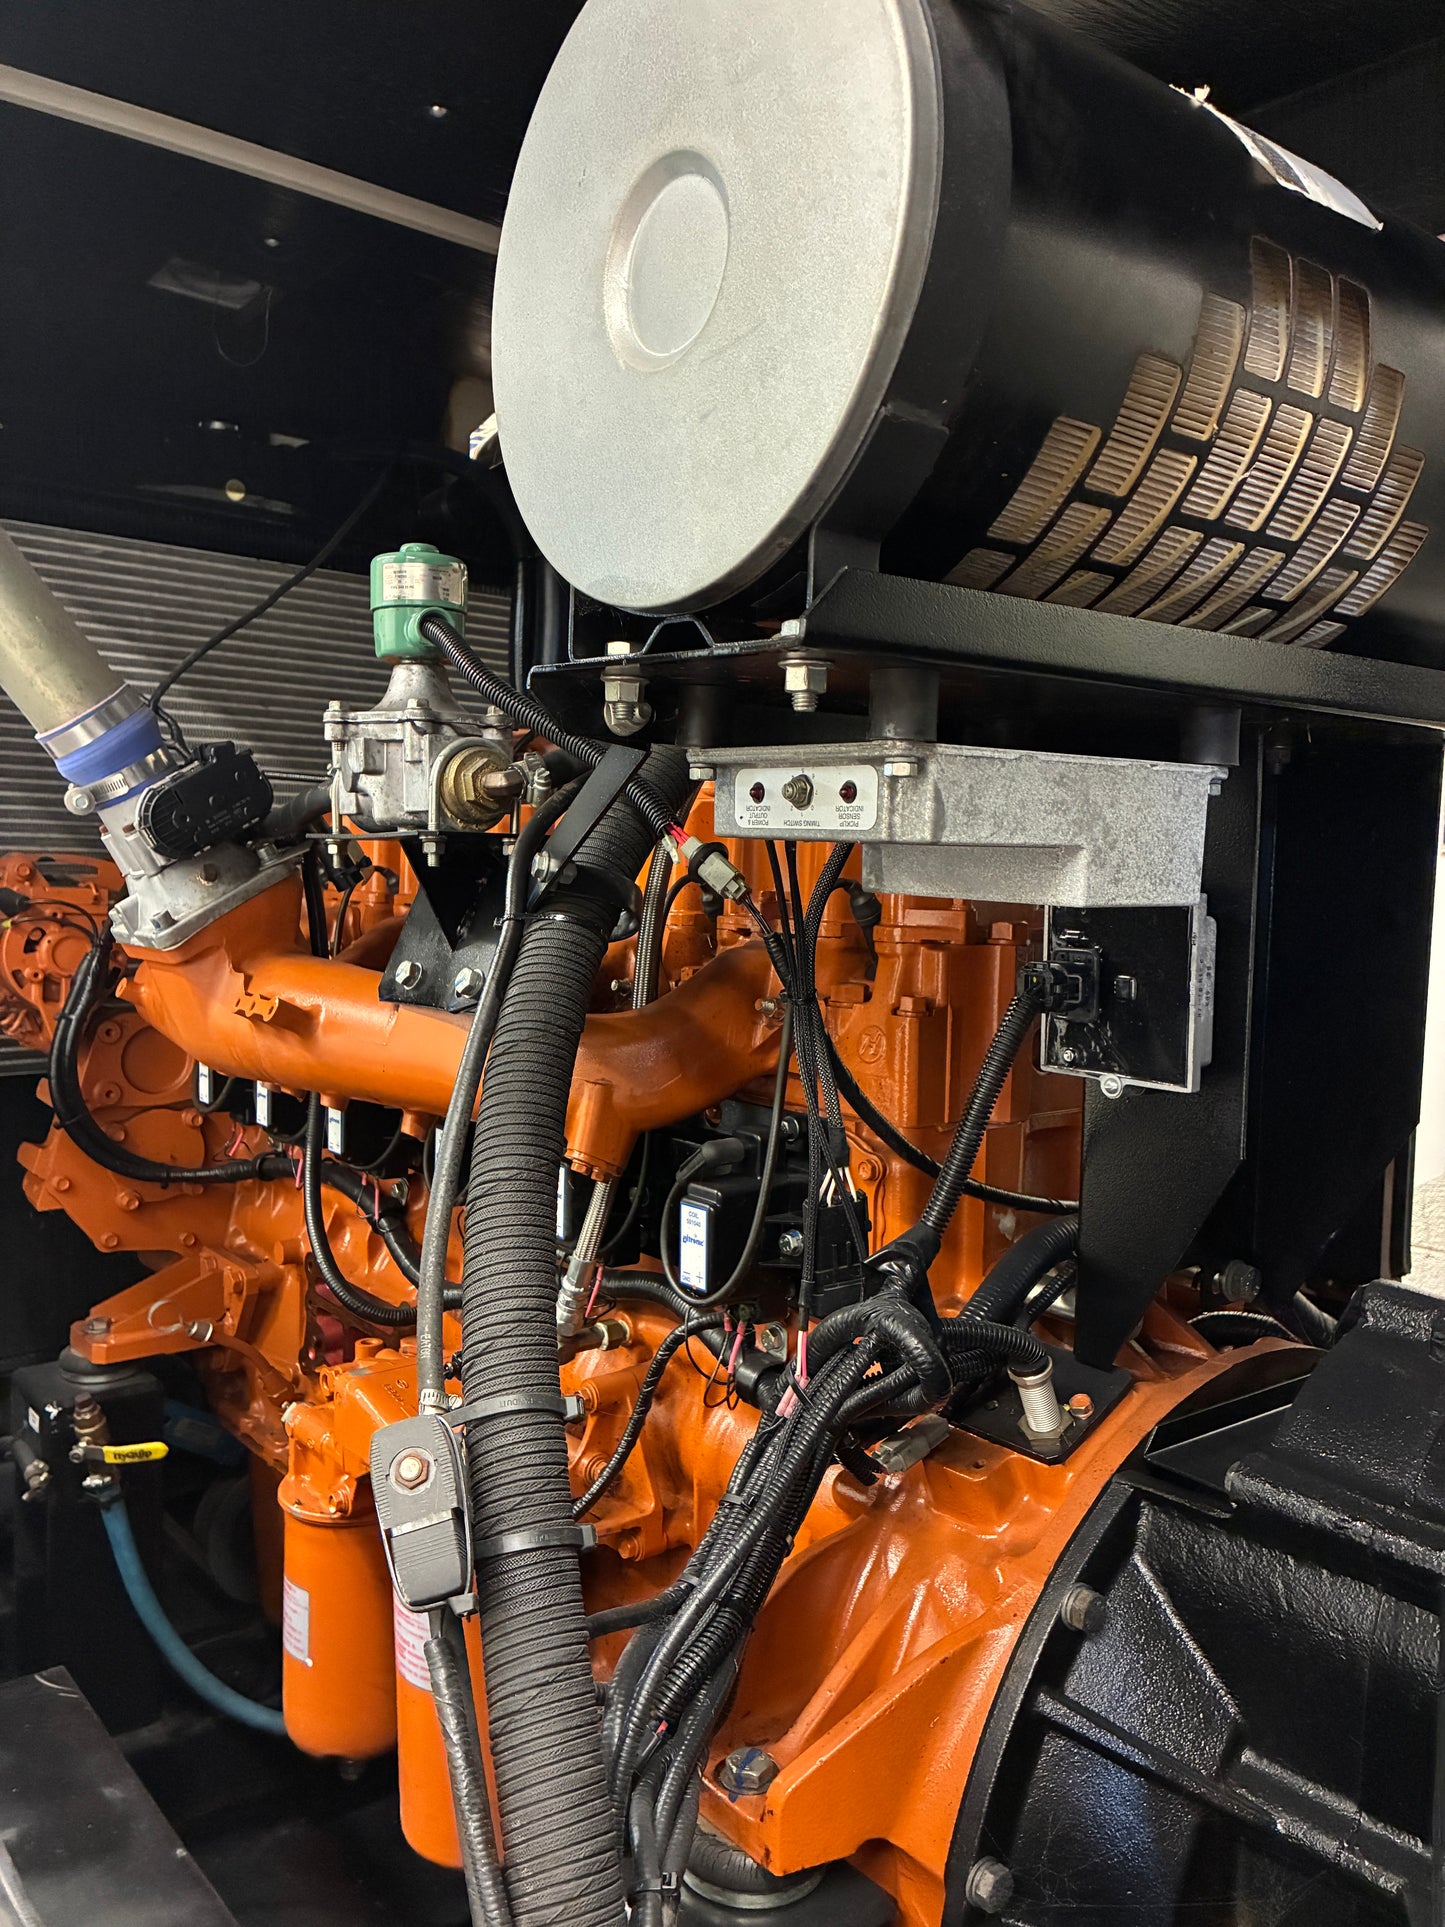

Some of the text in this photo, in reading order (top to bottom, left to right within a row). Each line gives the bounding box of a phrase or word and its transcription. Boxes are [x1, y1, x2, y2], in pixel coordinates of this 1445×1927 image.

[839, 812, 861, 820] SENSOR
[803, 819, 820, 827] TIMING
[688, 1211, 700, 1219] COIL
